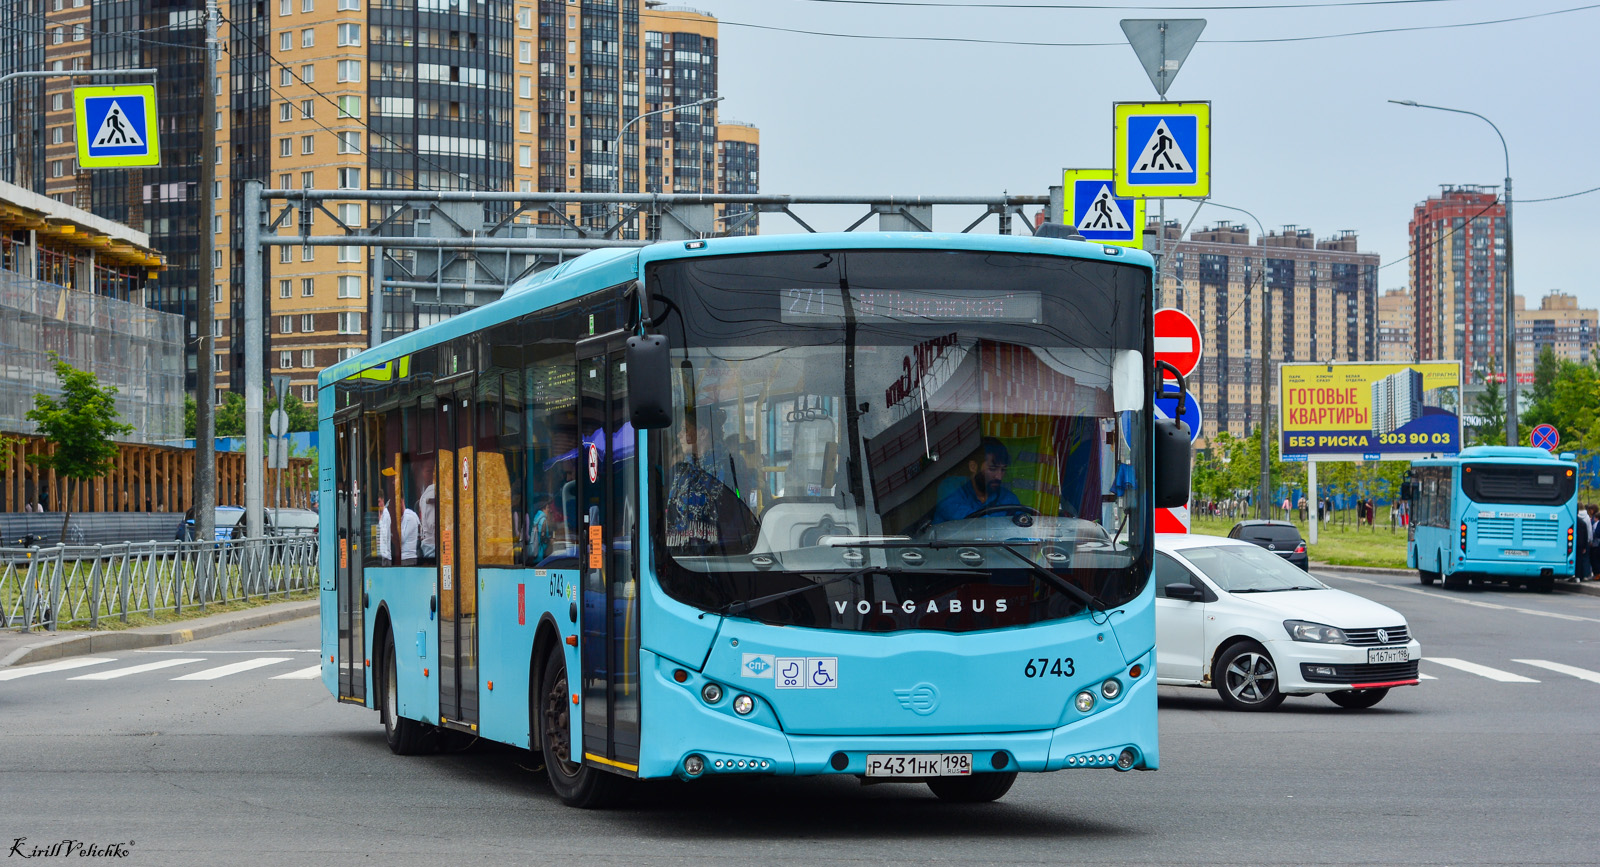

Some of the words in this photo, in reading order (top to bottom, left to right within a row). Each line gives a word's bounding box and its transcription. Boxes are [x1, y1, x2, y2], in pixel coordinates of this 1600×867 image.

[788, 288, 825, 314] 271
[1289, 387, 1358, 405] ГОТОВЫЕ
[1289, 407, 1368, 425] КВАРТИРЫ
[1289, 436, 1315, 447] БЕЗ
[1319, 435, 1369, 446] РИСКА
[1379, 433, 1406, 444] 303
[1409, 433, 1429, 444] 90
[1431, 433, 1450, 444] 03
[550, 573, 564, 598] 6743
[834, 599, 1008, 614] VOLGABUS
[748, 661, 767, 670] СПГ
[1024, 657, 1075, 678] 6743
[872, 757, 939, 774] Р431НК
[943, 755, 968, 769] 198
